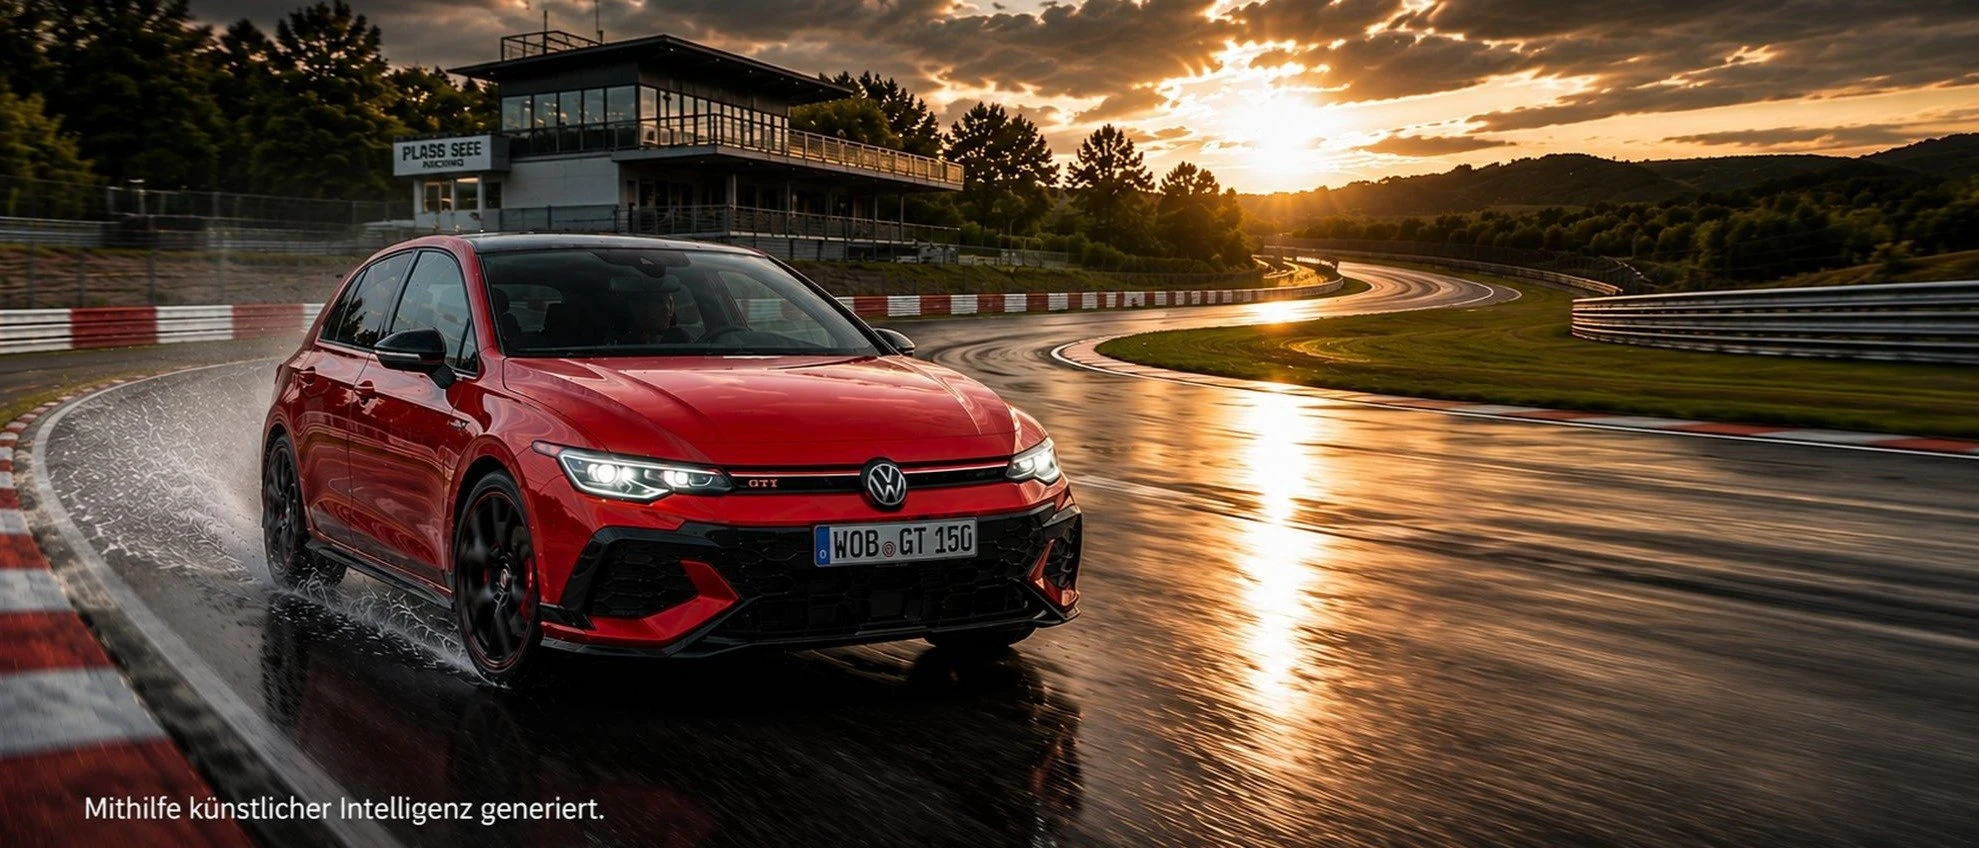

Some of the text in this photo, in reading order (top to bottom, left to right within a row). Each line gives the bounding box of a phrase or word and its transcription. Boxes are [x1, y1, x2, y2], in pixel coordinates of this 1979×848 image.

[402, 141, 482, 161] PLASS SEEE
[833, 529, 879, 559] WOB
[899, 527, 927, 556] GT
[934, 524, 972, 554] 150
